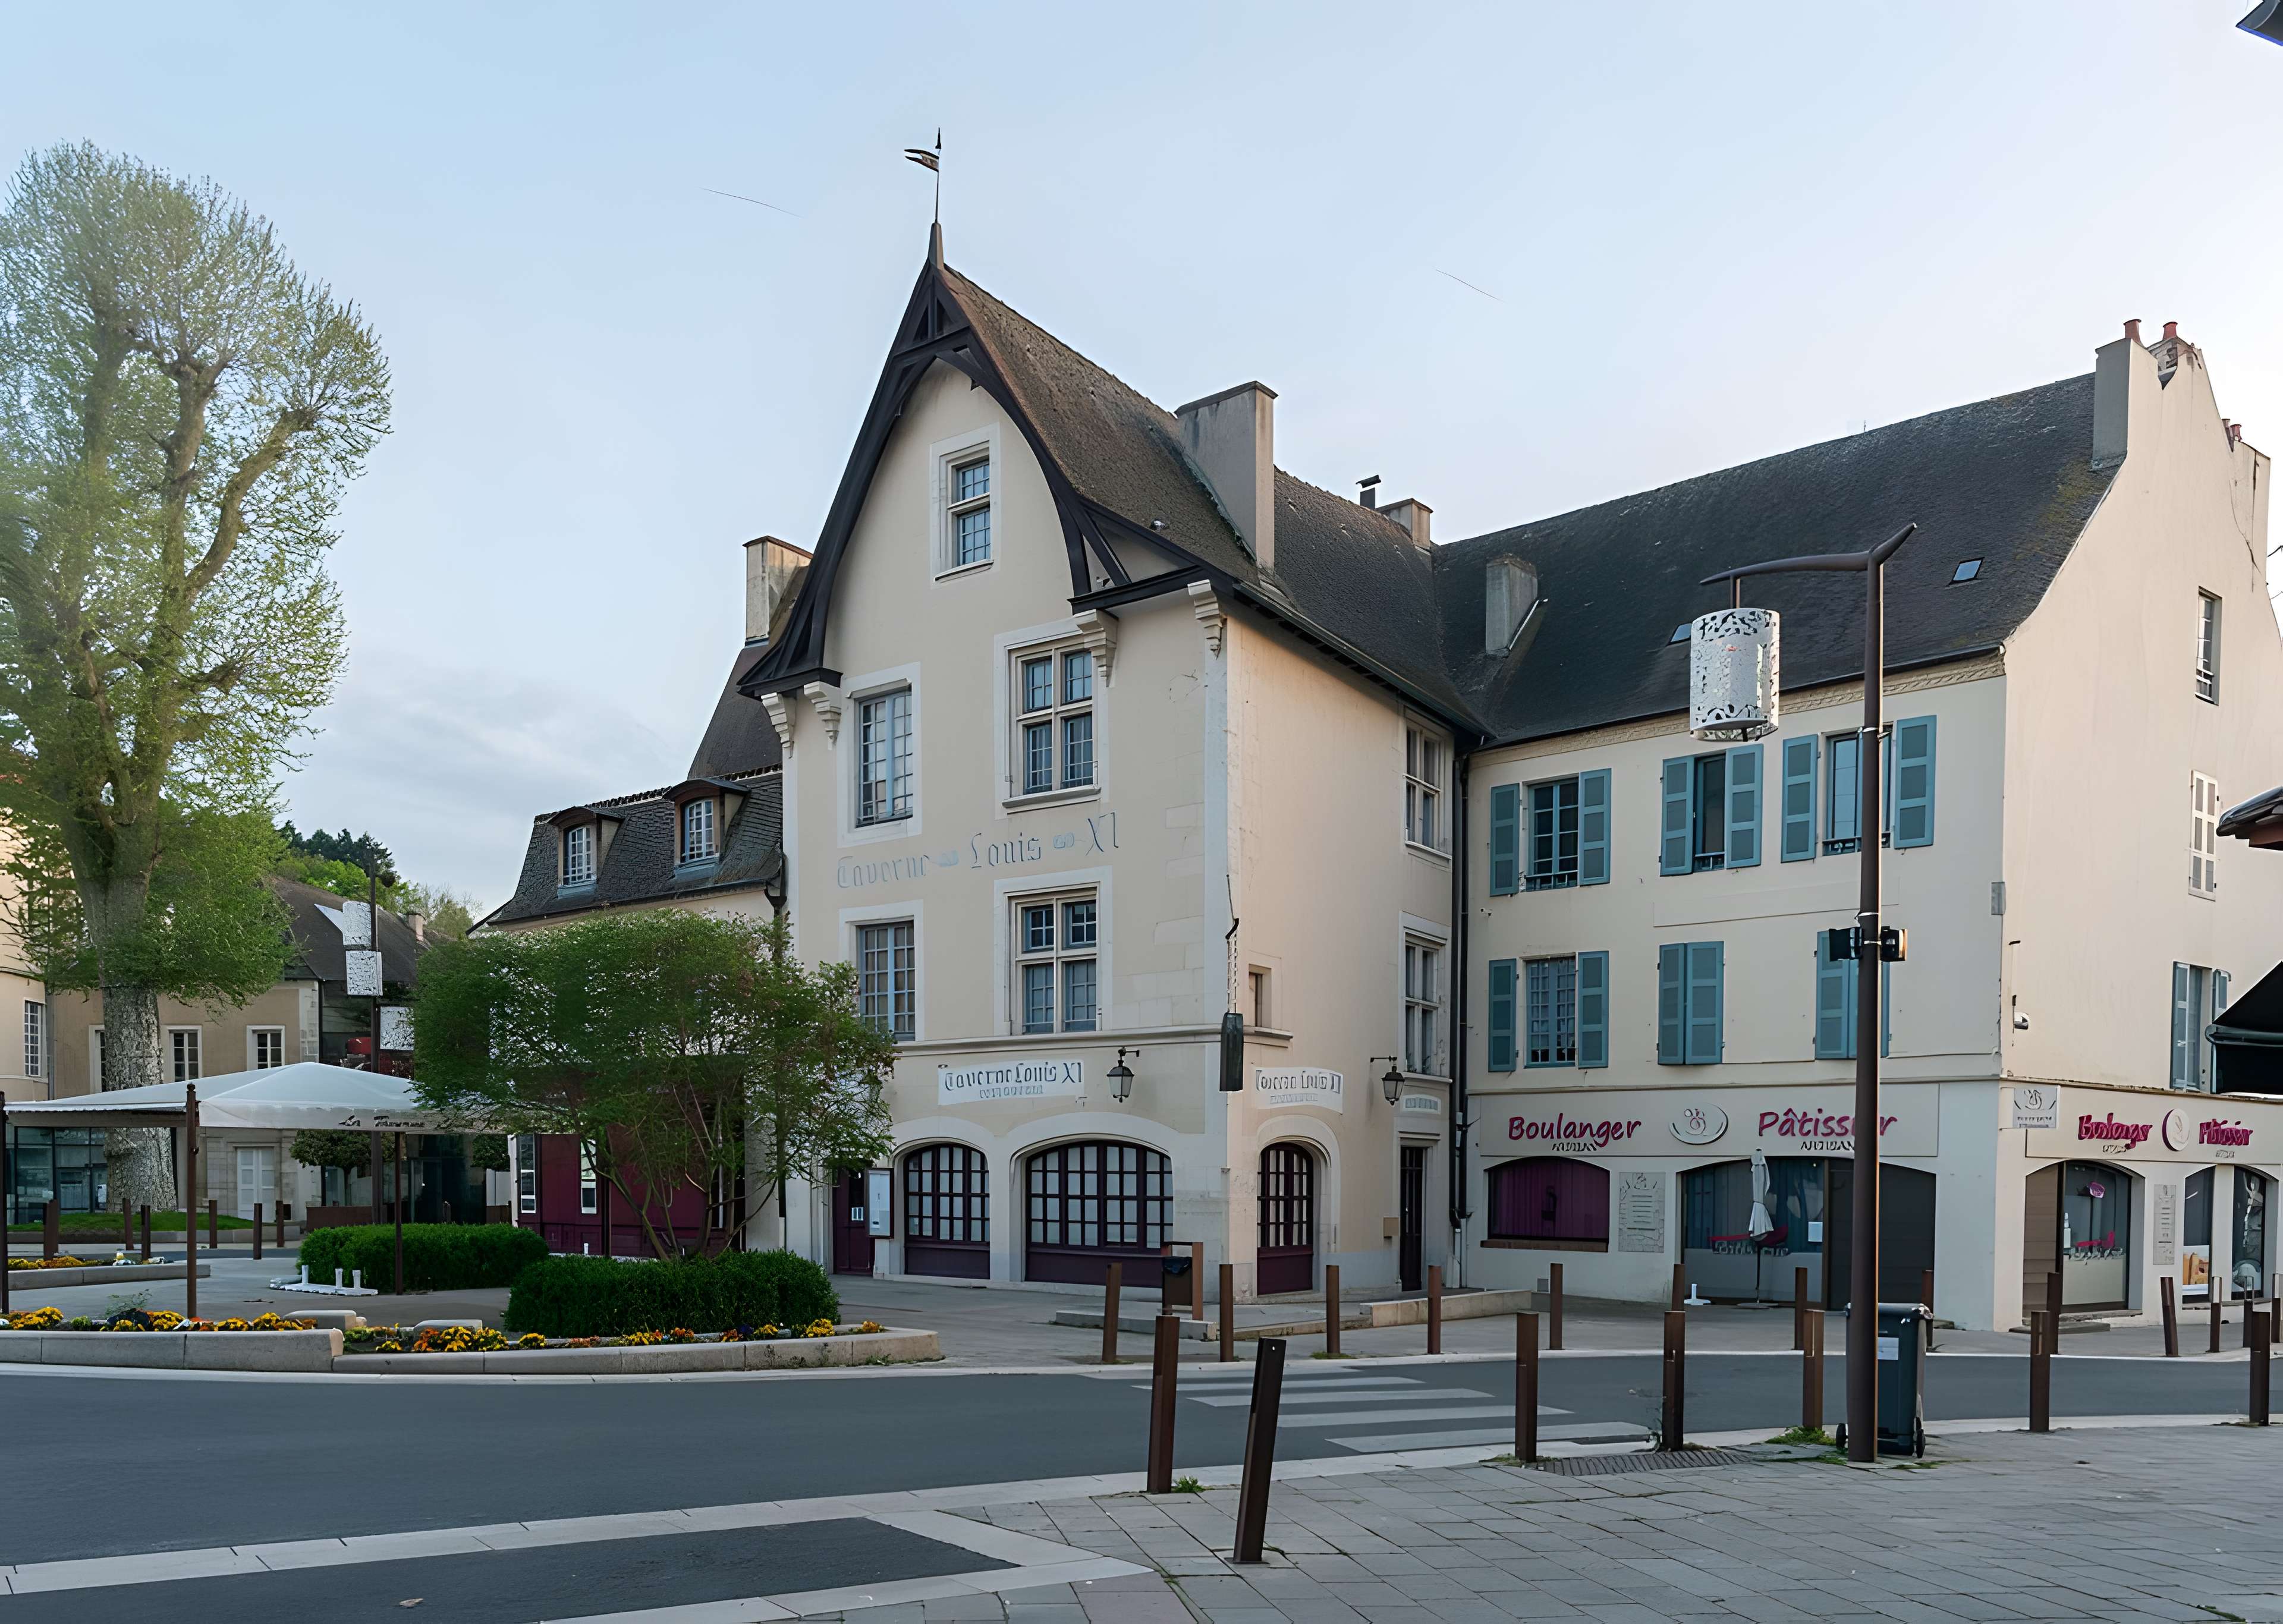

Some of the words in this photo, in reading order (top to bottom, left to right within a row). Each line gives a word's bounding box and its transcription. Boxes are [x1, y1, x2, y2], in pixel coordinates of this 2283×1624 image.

[971, 832, 1041, 869] Louis
[1508, 1112, 1642, 1148] Boulanger
[1758, 1107, 1898, 1137] Pâtissr
